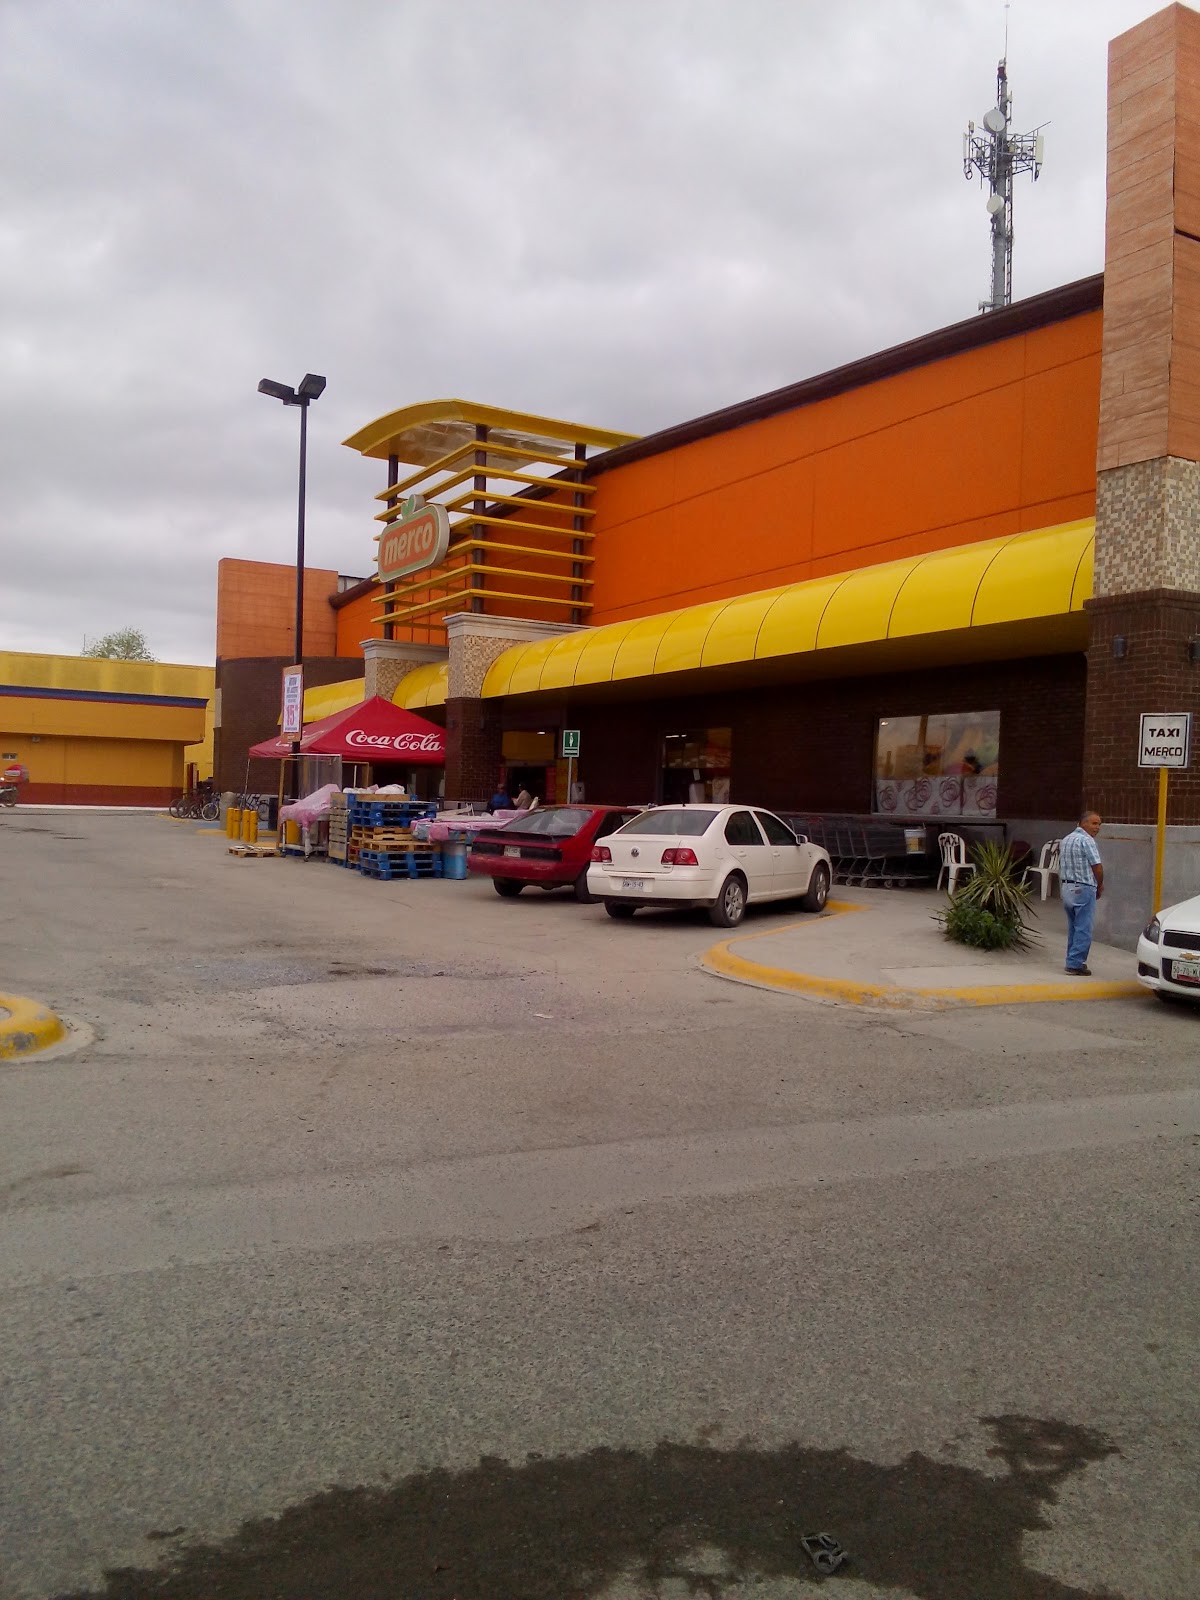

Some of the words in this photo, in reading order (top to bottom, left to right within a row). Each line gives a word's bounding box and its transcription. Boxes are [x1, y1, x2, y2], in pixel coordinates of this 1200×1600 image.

[383, 521, 433, 566] merco
[345, 729, 442, 751] Coca-Cola
[1148, 728, 1180, 738] TAXI
[1144, 746, 1183, 757] MERCO
